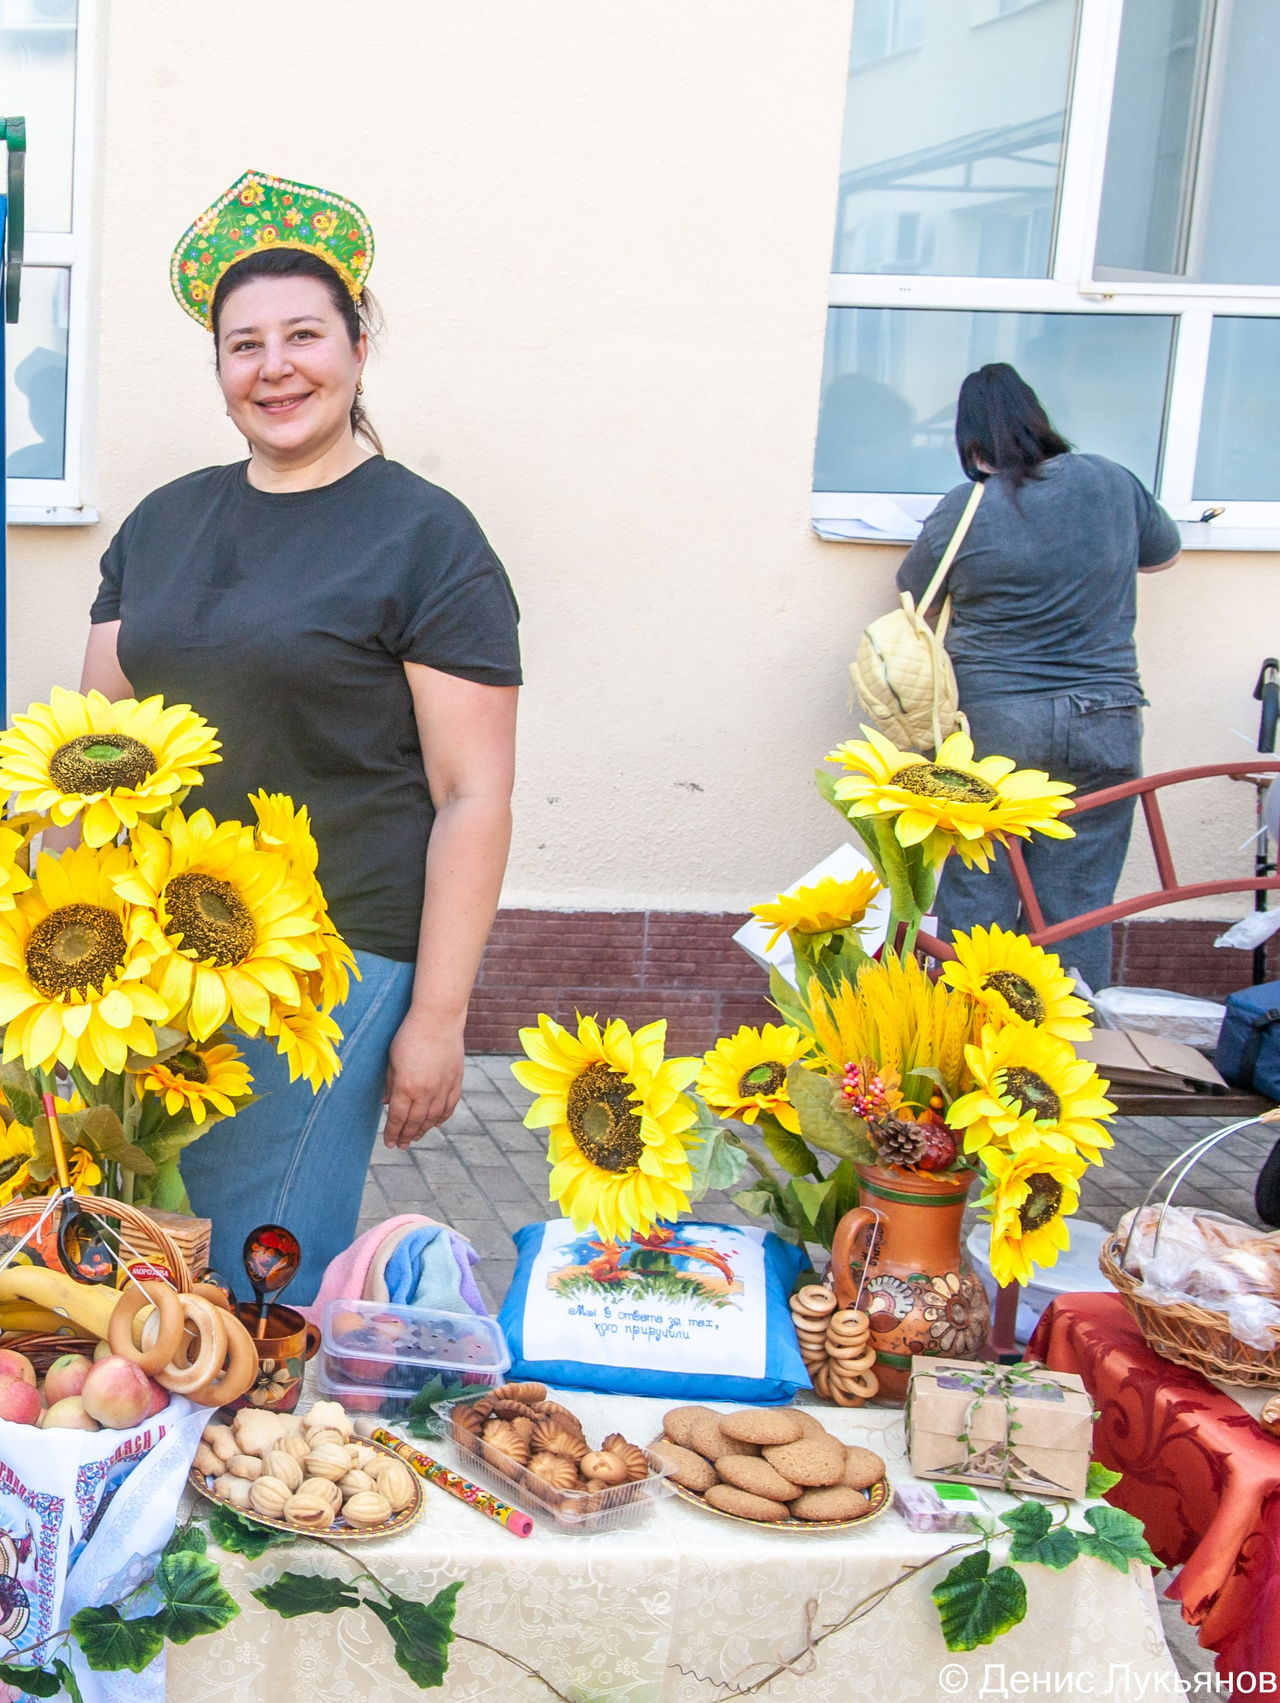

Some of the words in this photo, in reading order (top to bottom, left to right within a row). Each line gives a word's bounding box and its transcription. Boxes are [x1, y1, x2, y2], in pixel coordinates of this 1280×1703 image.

[568, 1304, 596, 1317] Мы
[604, 1305, 612, 1318] в
[618, 1309, 663, 1323] ответе
[668, 1316, 681, 1329] за
[688, 1318, 719, 1330] тех,
[594, 1322, 618, 1337] кого
[625, 1325, 690, 1341] приручили
